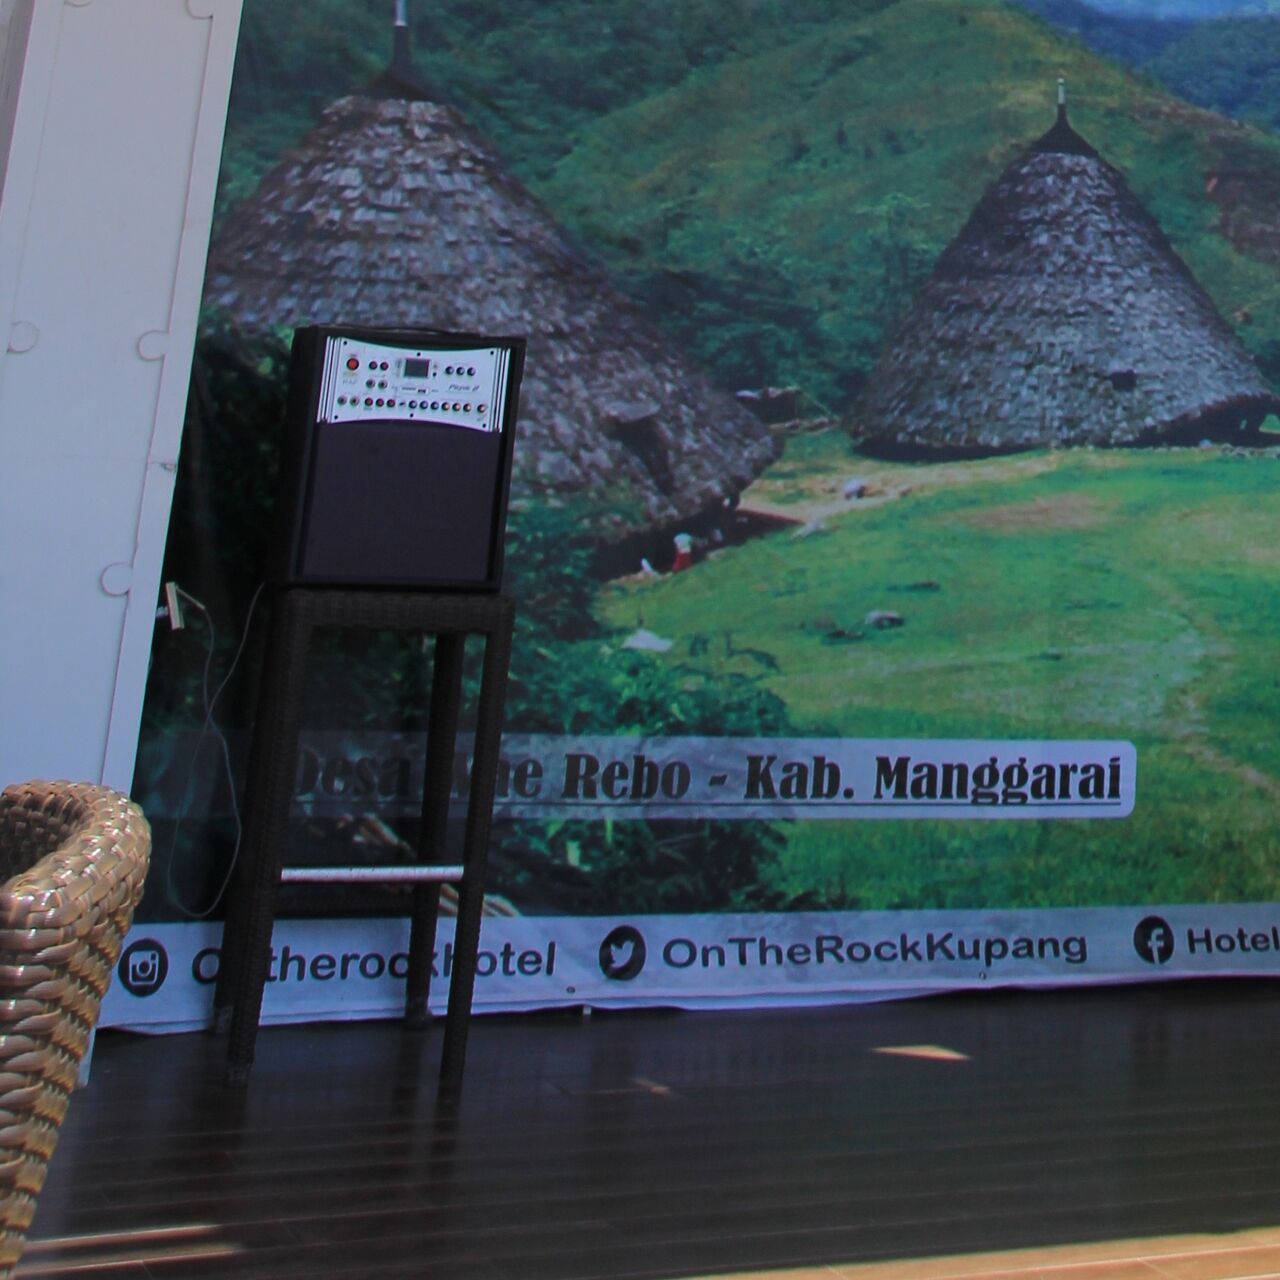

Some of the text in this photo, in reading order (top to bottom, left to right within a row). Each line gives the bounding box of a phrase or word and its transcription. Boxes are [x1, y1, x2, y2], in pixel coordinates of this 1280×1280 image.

[561, 754, 691, 800] Rebo
[744, 753, 855, 800] Kab.
[874, 755, 1123, 806] Manggarai
[663, 931, 1087, 968] OnTheRockKupang
